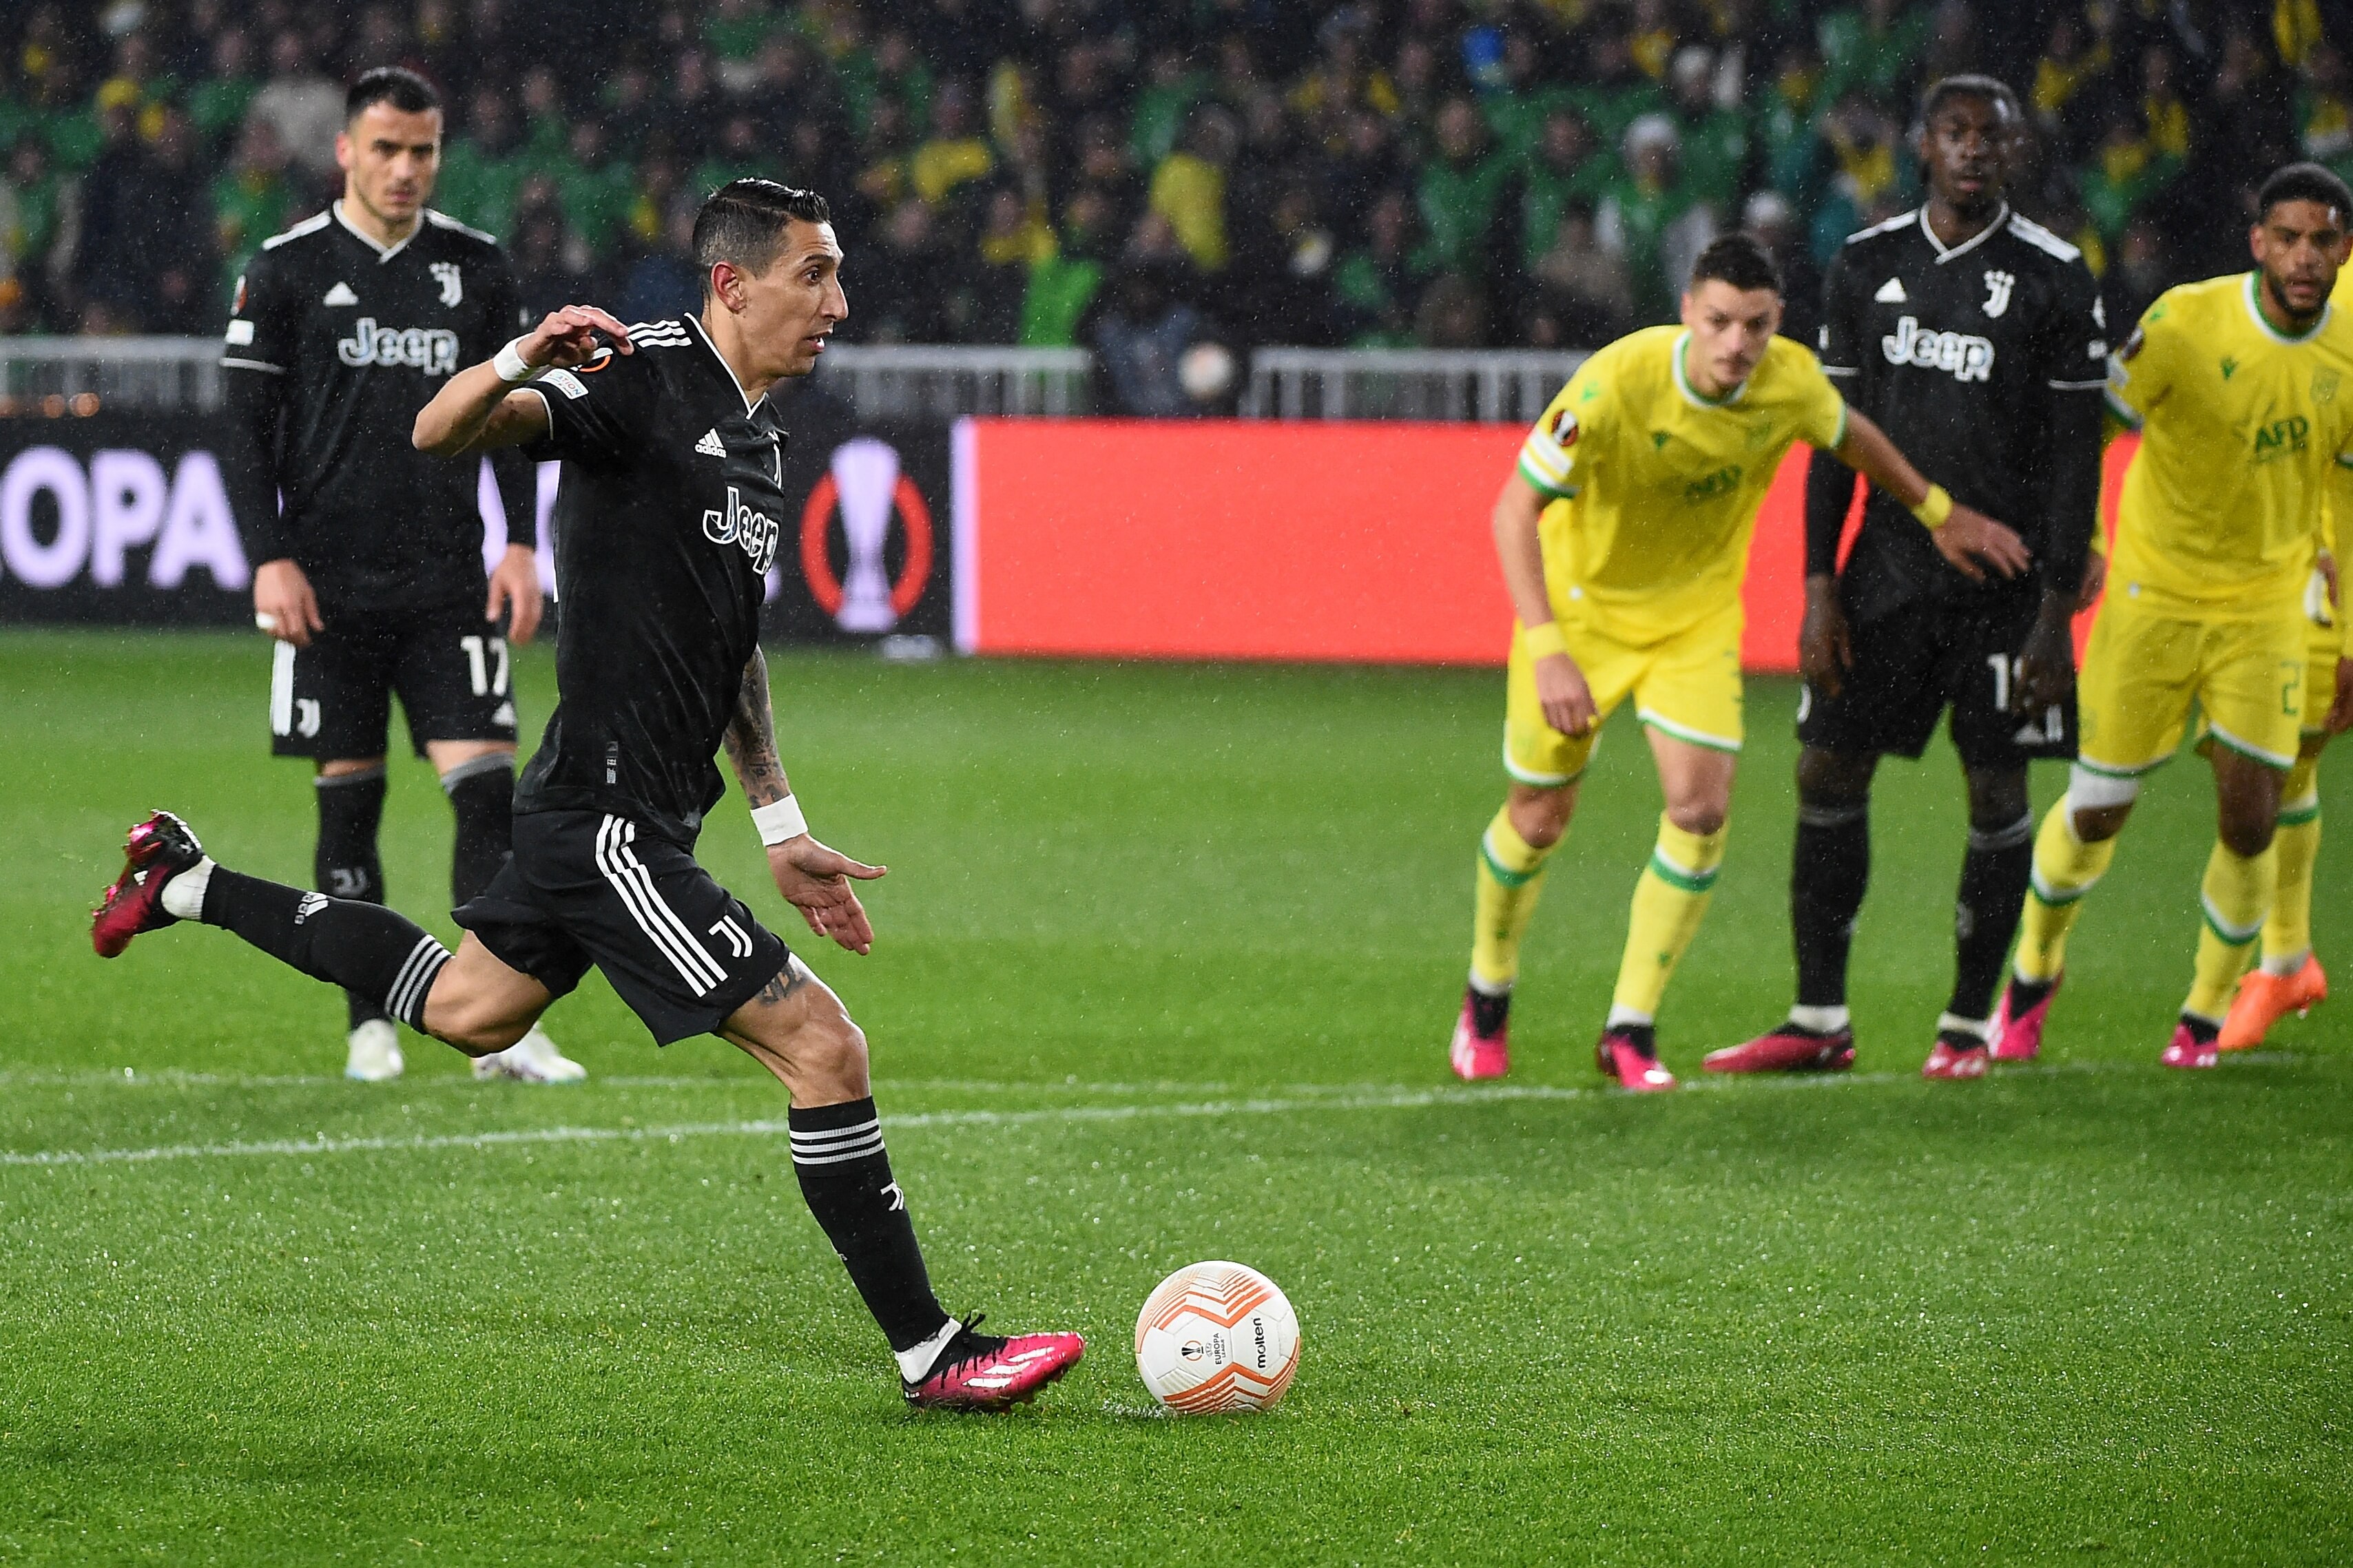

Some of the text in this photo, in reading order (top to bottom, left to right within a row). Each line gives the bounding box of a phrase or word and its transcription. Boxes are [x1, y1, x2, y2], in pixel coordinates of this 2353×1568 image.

[338, 317, 459, 376] Jeep
[1881, 315, 1996, 383] Jeep
[554, 375, 581, 396] ATION
[0, 445, 251, 591] OPA
[703, 485, 779, 575] Jeep
[460, 635, 508, 697] 17
[1987, 653, 2024, 712] 1
[2281, 660, 2301, 716] 2
[1213, 1332, 1222, 1365] EUROPA
[1253, 1317, 1266, 1369] molten
